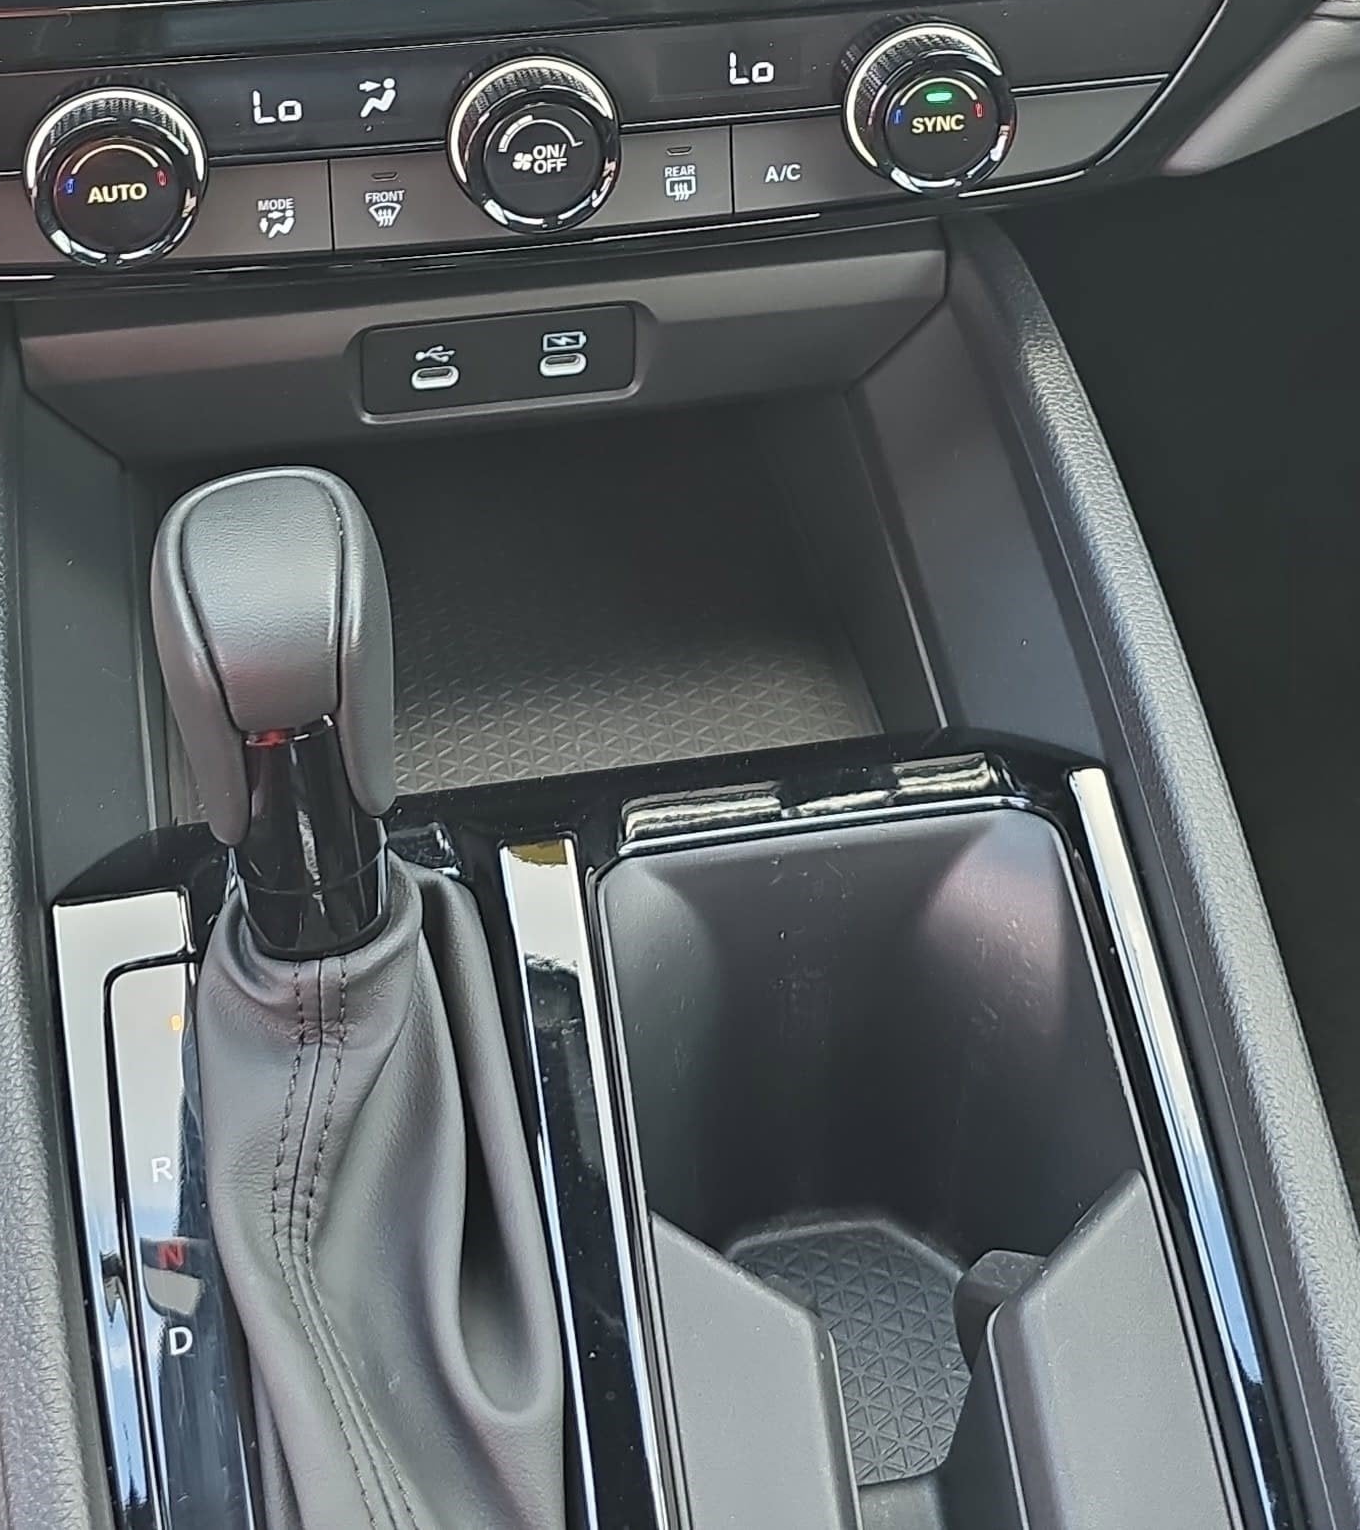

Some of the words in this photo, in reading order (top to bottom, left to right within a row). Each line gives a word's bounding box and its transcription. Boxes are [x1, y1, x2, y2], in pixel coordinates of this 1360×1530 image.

[729, 52, 774, 85] Lo
[252, 90, 302, 124] Lo
[911, 114, 965, 134] SYNC
[533, 141, 567, 159] ON/
[533, 157, 567, 175] OFF
[665, 165, 695, 178] REAR
[765, 164, 801, 183] A/C
[87, 182, 147, 204] AUTO
[364, 189, 405, 206] FRONT
[257, 197, 294, 213] MODE
[151, 1156, 173, 1182] R
[158, 1241, 186, 1269] N
[169, 1327, 193, 1355] D
